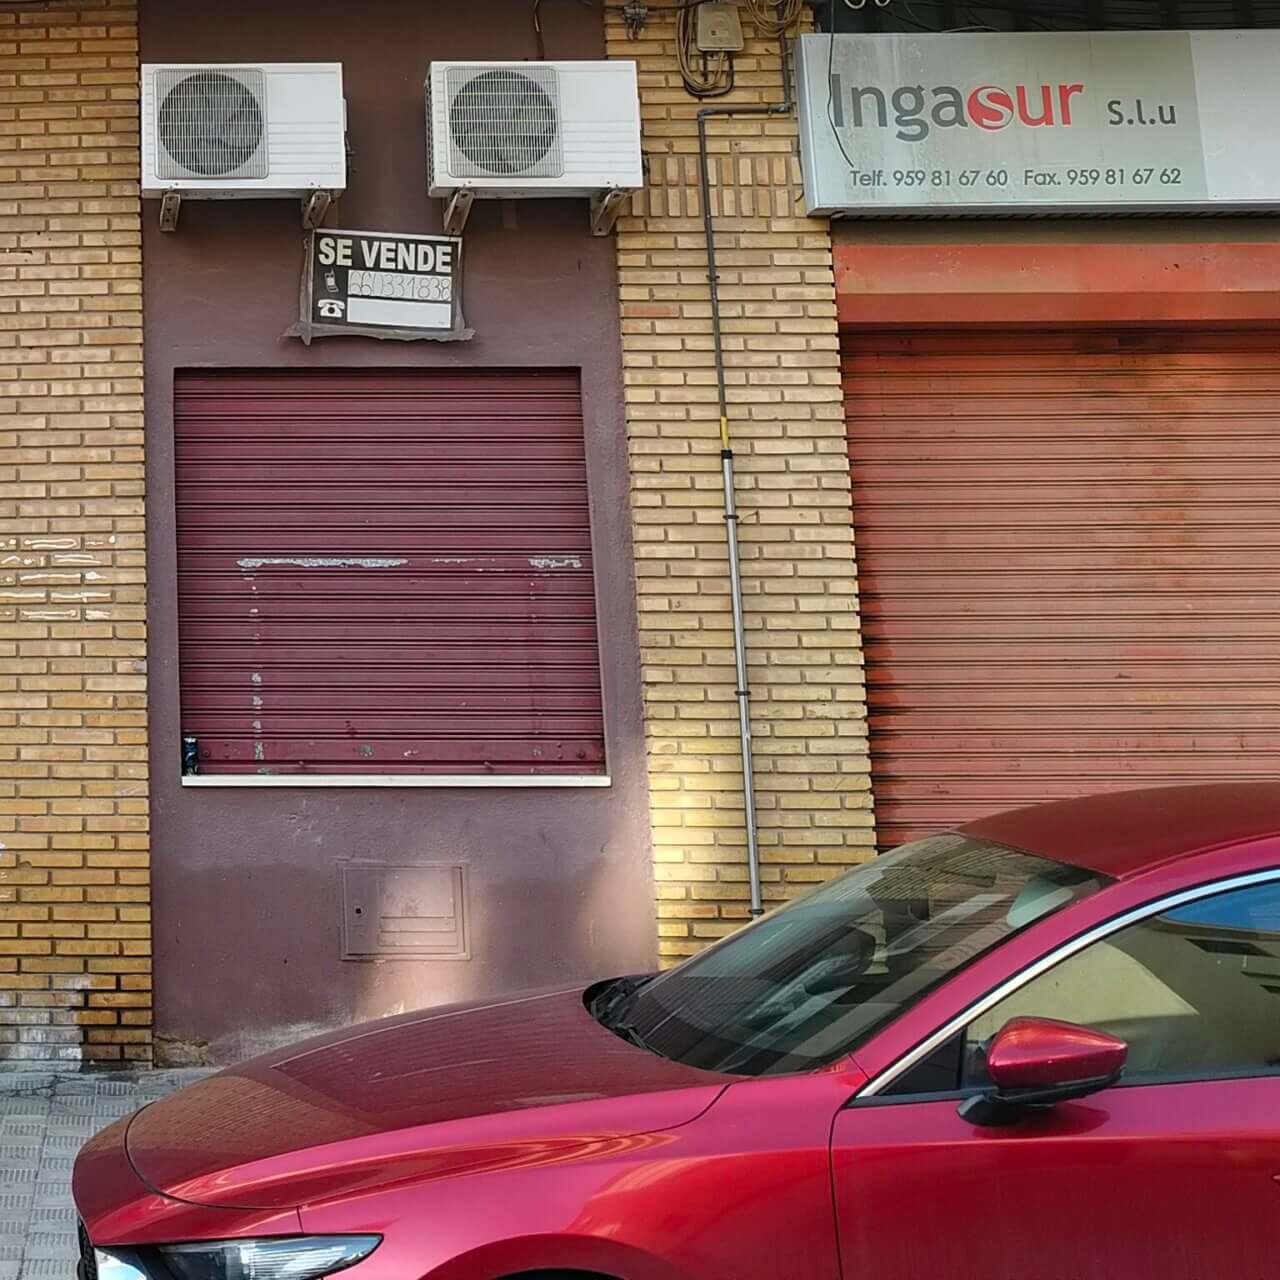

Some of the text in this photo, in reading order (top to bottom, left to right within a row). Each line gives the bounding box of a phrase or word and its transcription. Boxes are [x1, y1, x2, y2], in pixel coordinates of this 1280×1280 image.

[831, 73, 1084, 142] Ingasur
[850, 167, 1182, 187] Telf. 959 81 67 60 Fax. 959 81 67 62
[318, 237, 453, 273] SE VENDE
